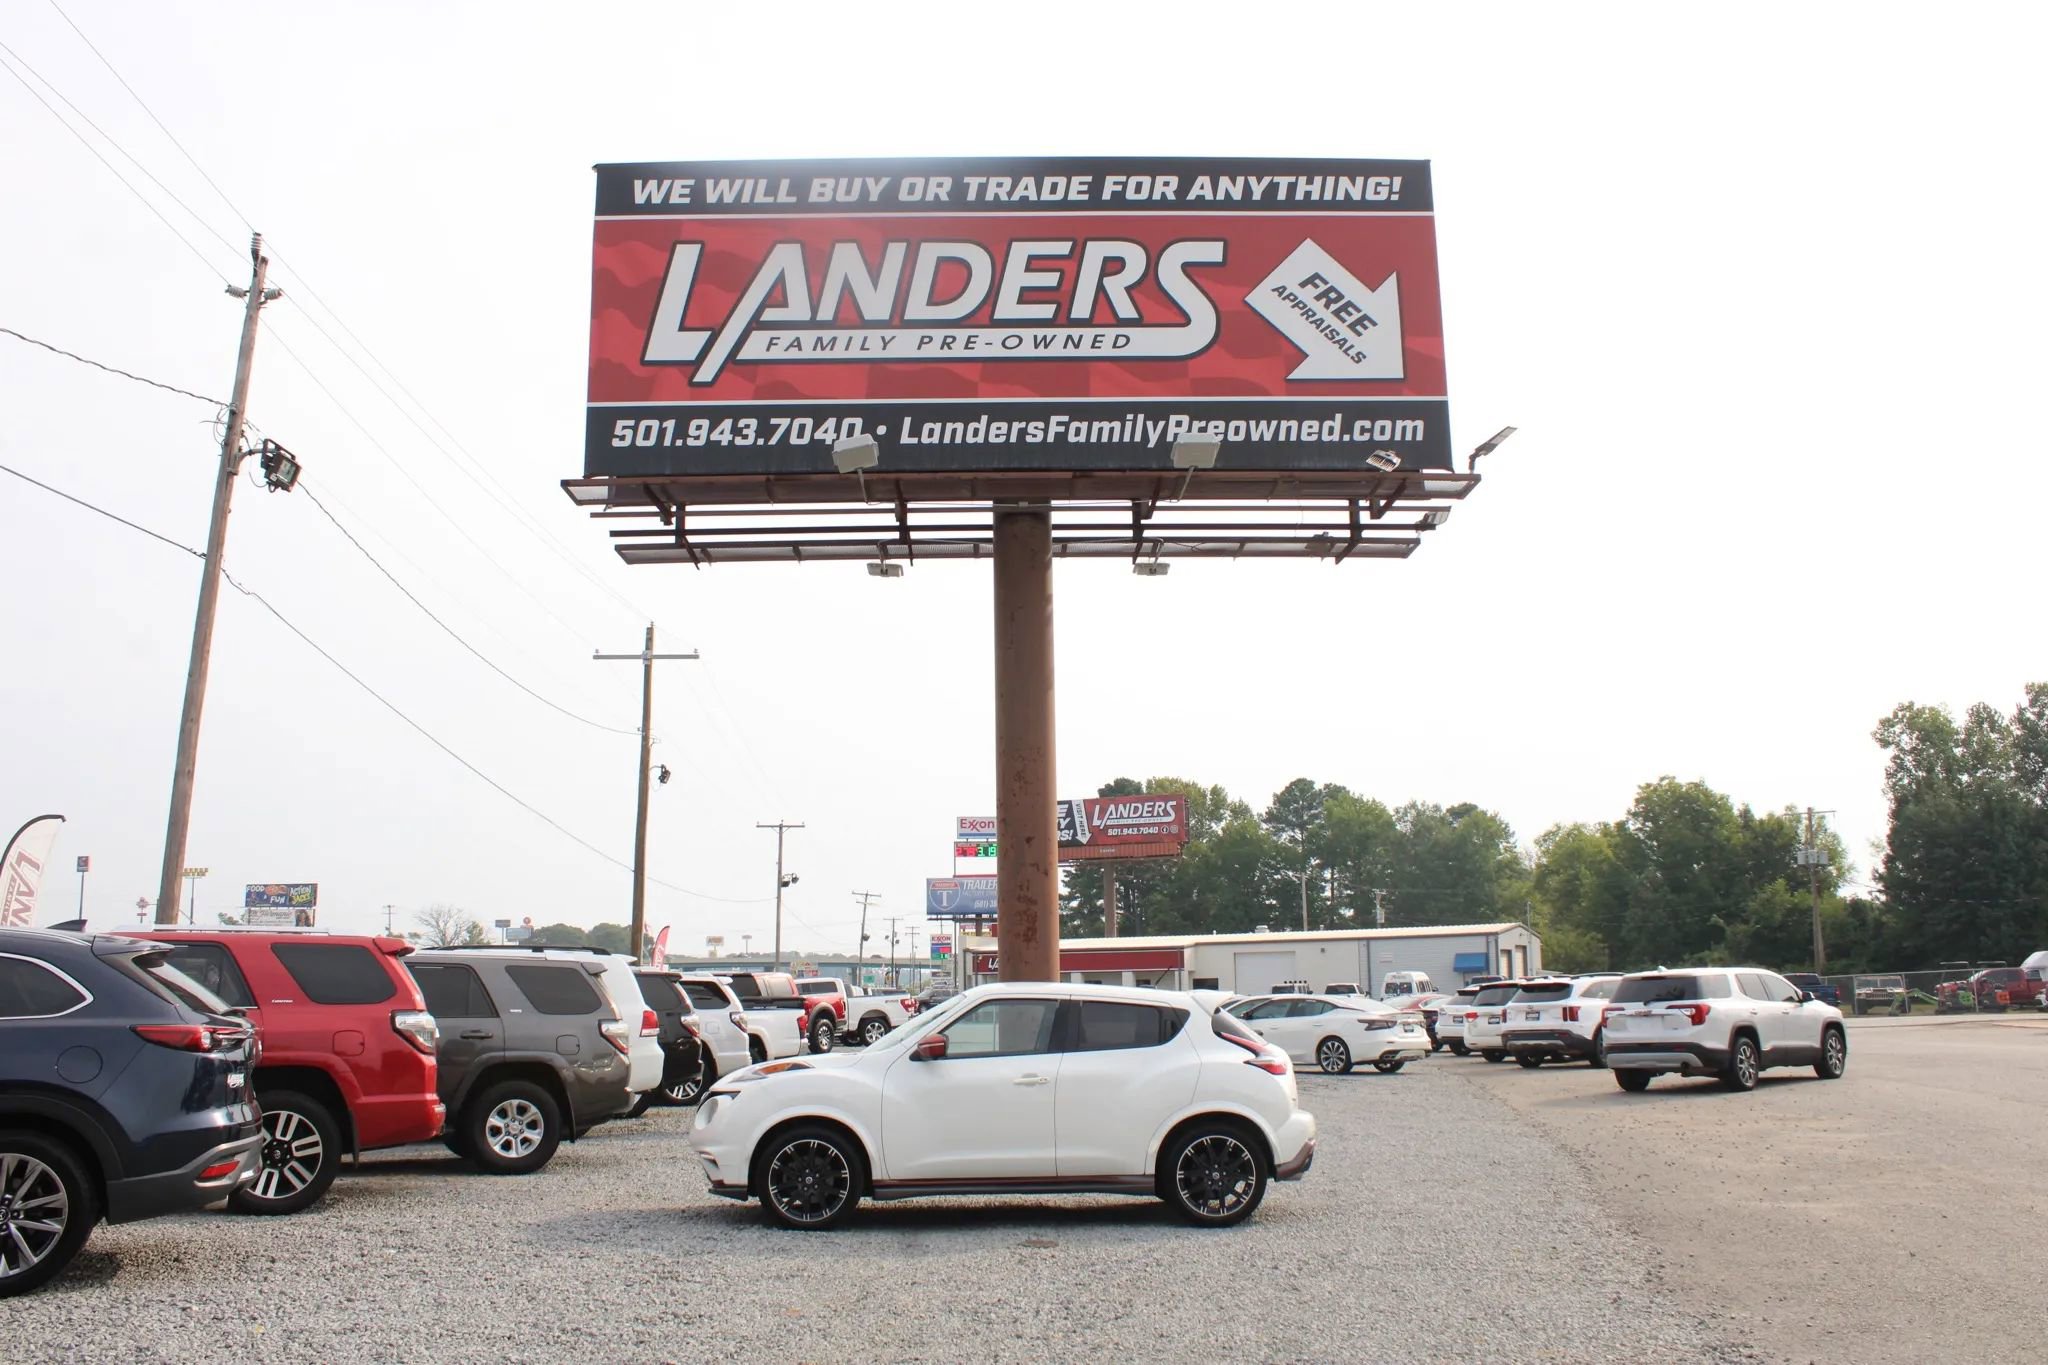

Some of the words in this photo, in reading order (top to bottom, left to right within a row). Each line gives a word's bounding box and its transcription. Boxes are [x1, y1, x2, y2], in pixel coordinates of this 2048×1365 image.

[633, 178, 695, 205] WE
[704, 178, 798, 204] WILL
[807, 177, 891, 203] BUY
[898, 176, 953, 202] OR
[962, 176, 1093, 202] TRADE
[1101, 175, 1179, 201] FOR
[1186, 175, 1403, 201] ANYTHING!
[642, 240, 1227, 385] LANDERS
[1297, 271, 1379, 338] FREE
[1270, 284, 1367, 366] APPRAISALS
[765, 334, 897, 353] FAMILY
[916, 333, 1132, 352] PRE-OWNED
[611, 417, 863, 448] 501.943.7040
[900, 413, 1425, 448] LandersFamilyPreowned.com
[960, 818, 995, 832] Exxon
[1092, 800, 1177, 829] LANDERS
[246, 885, 265, 893] FOOD
